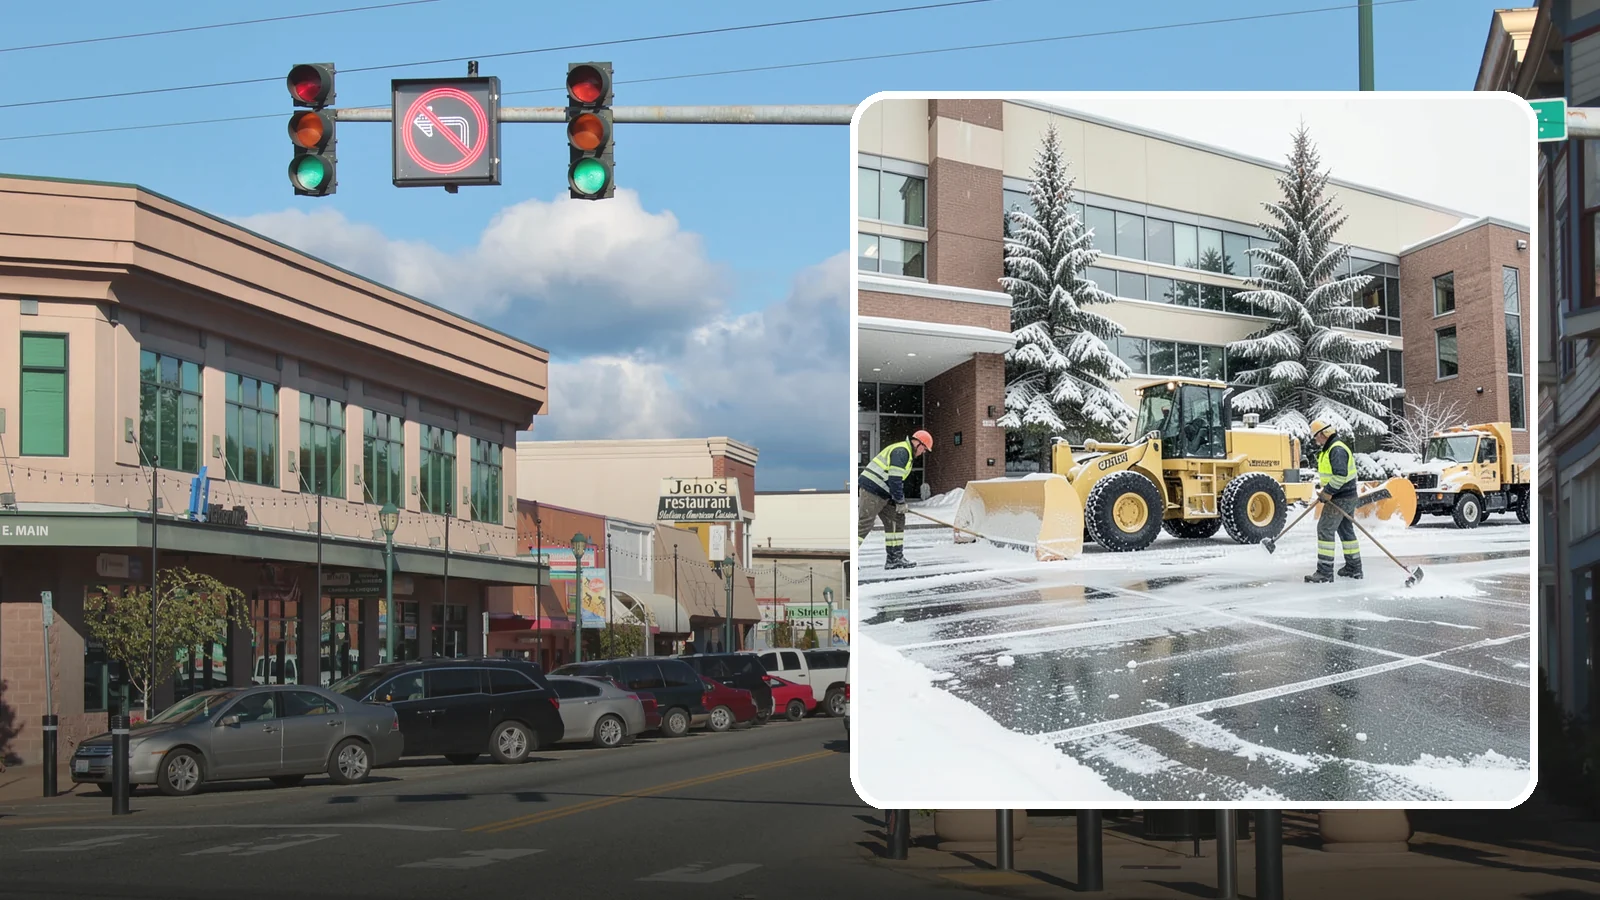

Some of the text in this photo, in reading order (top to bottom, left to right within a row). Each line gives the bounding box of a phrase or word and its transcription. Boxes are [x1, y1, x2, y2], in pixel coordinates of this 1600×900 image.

[669, 480, 727, 494] Jeno's
[665, 496, 731, 509] restaurant
[658, 510, 682, 519] Italian
[686, 509, 714, 519] American
[715, 509, 737, 519] Cuisine
[2, 525, 49, 536] E. MAIN
[797, 607, 828, 617] Street
